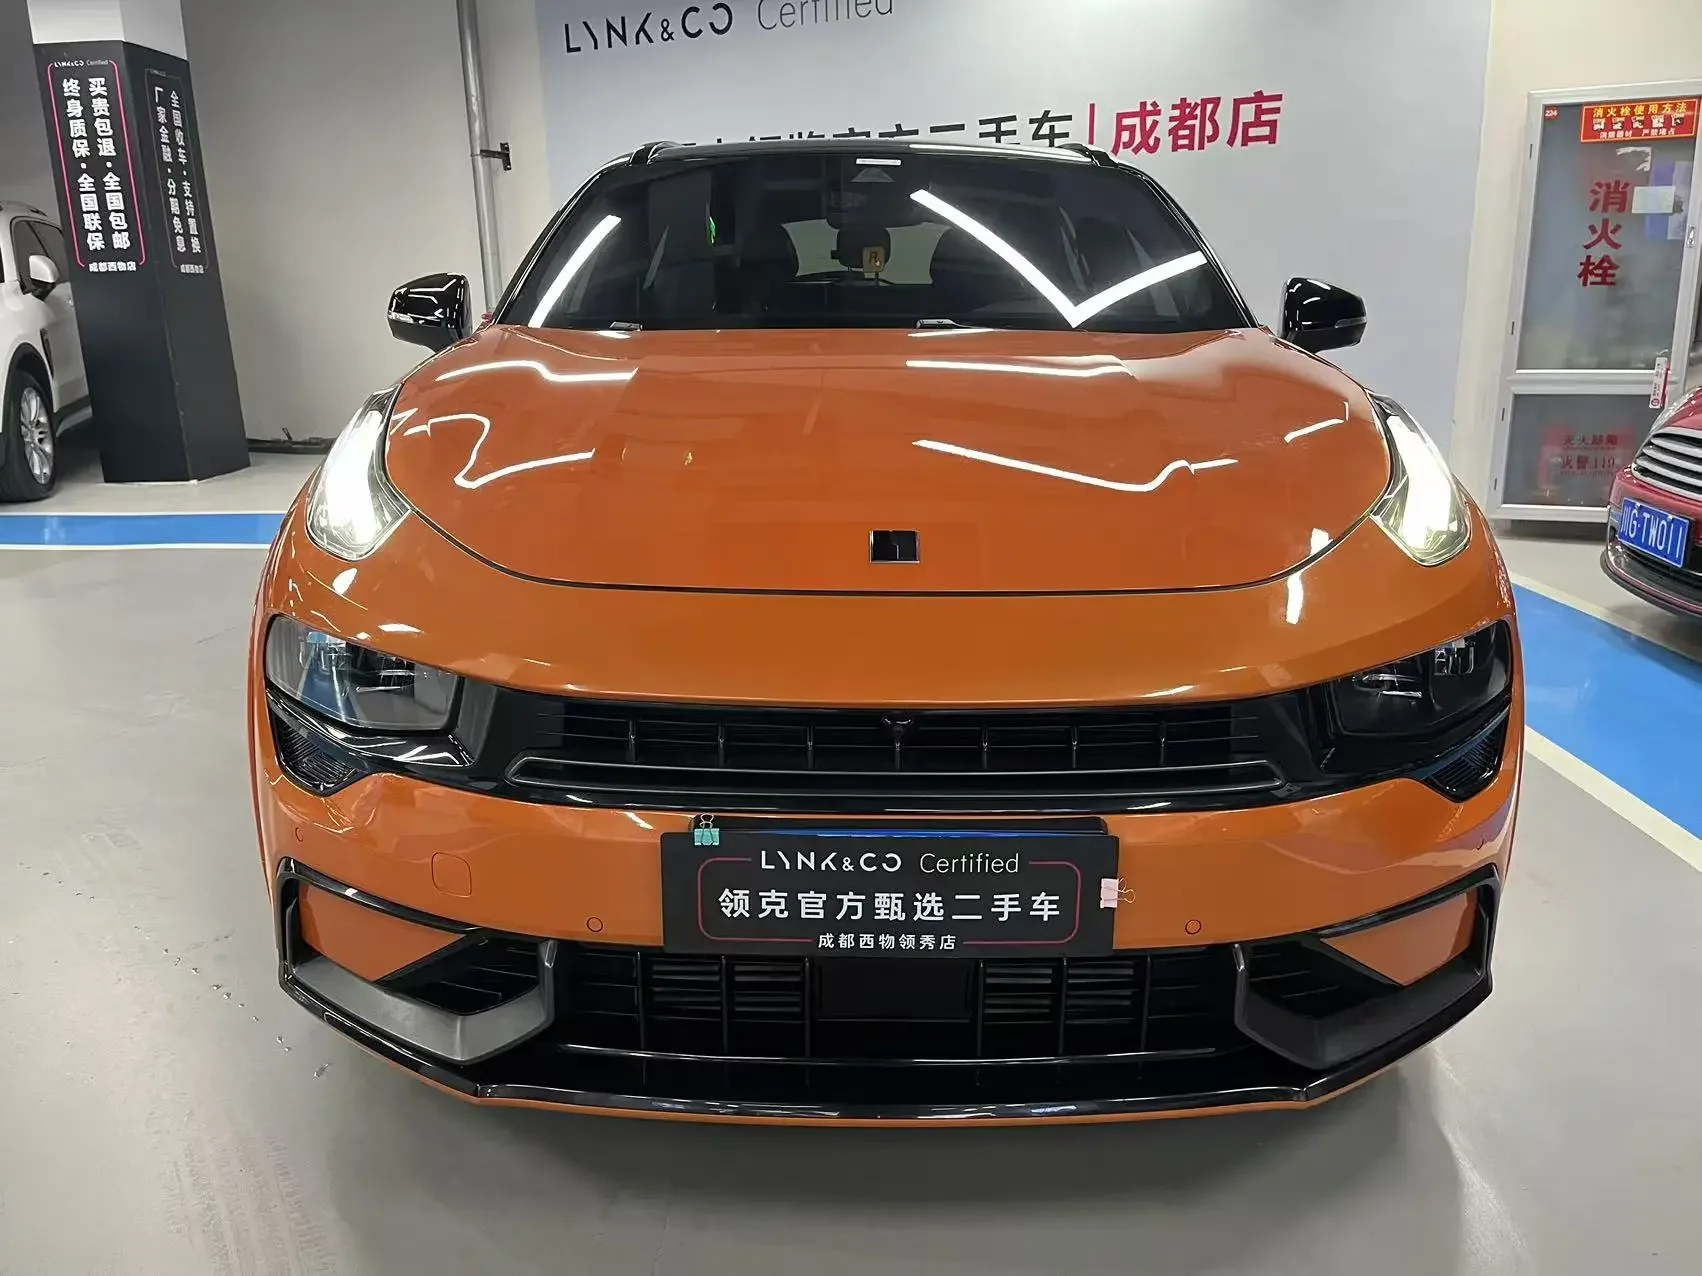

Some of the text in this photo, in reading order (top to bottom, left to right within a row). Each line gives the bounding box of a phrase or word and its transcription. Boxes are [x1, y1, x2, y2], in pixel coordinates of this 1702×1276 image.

[1110, 90, 1284, 156] 成都店
[1593, 102, 1687, 118] 消火栓使用方法
[1576, 179, 1631, 287] 消火栓
[760, 850, 1020, 873] LYNK&CO Certified
[717, 888, 1061, 922] 领克官方甄选二手车
[817, 933, 957, 951] 成都西物领秀店
